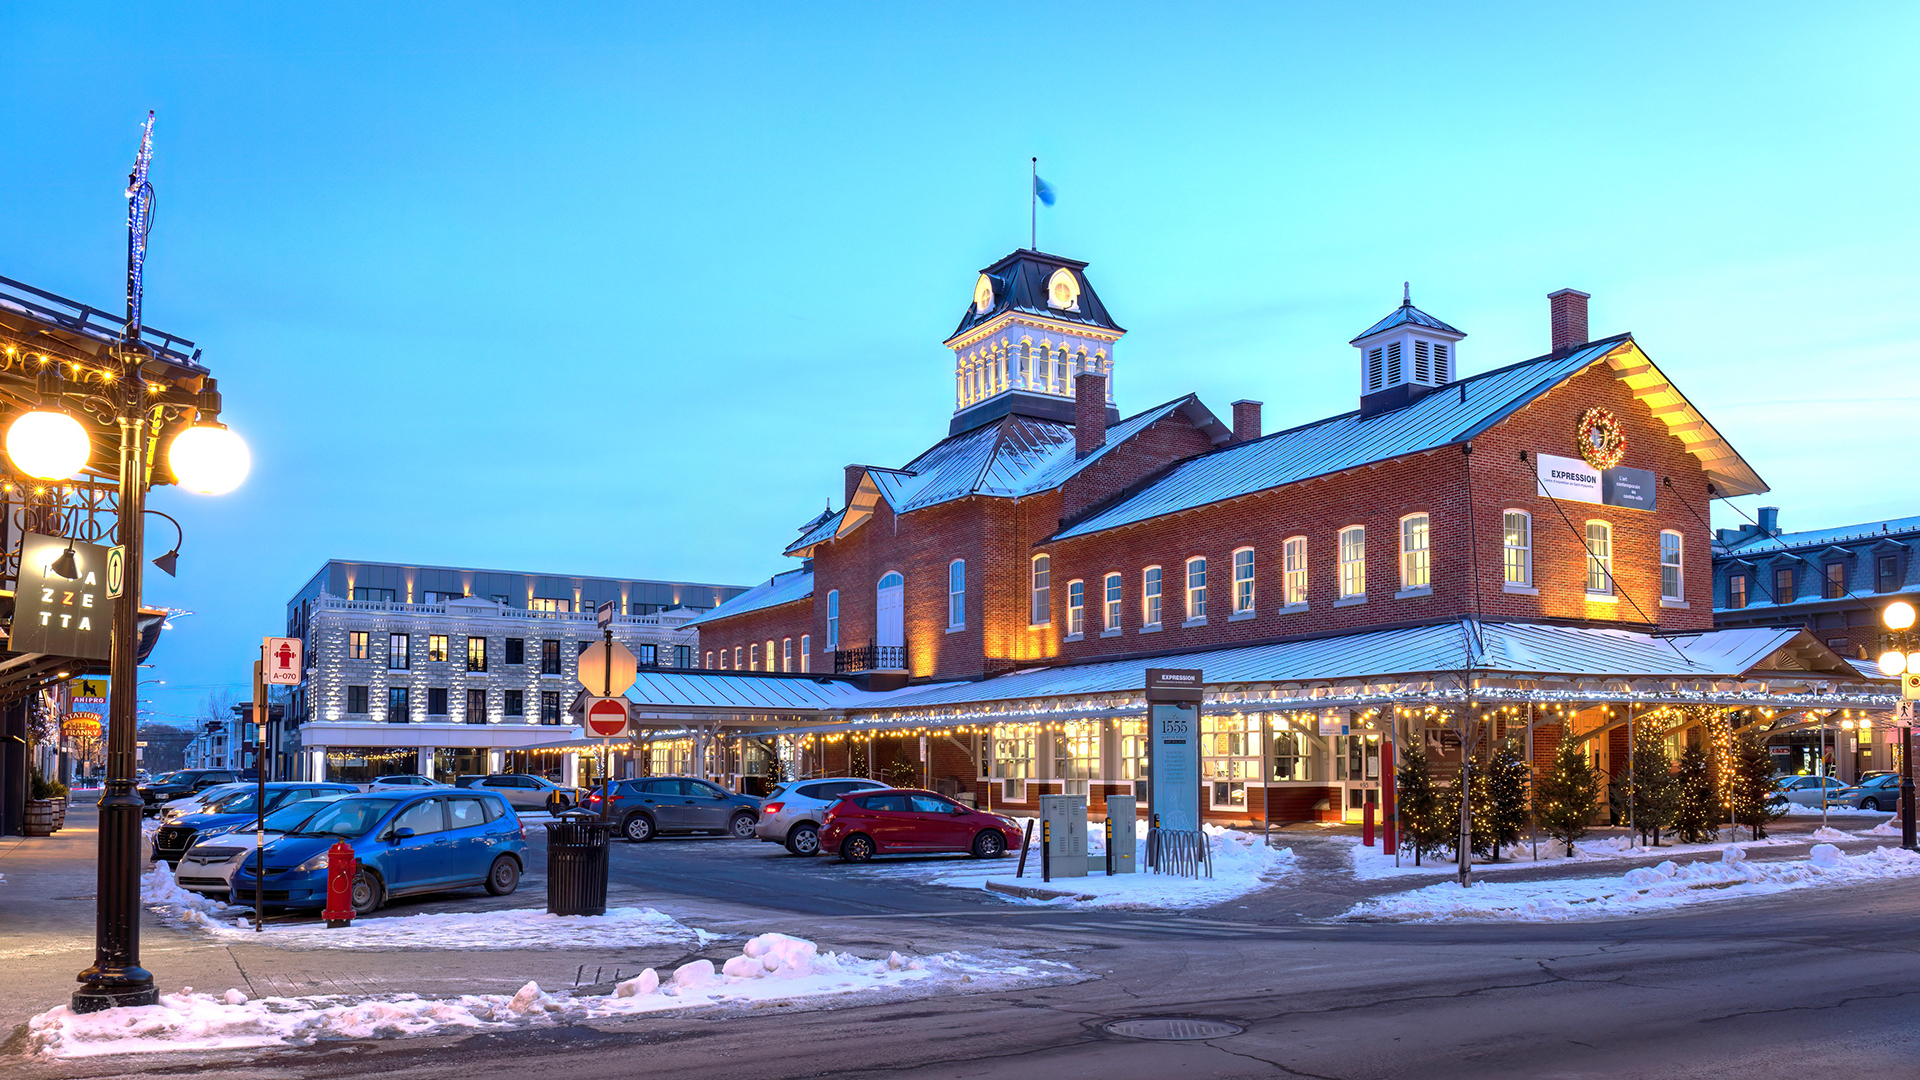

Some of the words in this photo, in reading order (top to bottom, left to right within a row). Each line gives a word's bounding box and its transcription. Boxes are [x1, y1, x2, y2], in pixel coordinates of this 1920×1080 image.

[1551, 469, 1597, 484] EXPRESSION
[39, 611, 92, 632] TTA
[273, 672, 297, 681] A-070
[73, 696, 104, 704] ANIPRO
[61, 711, 102, 722] STATION
[1161, 720, 1188, 734] 1555
